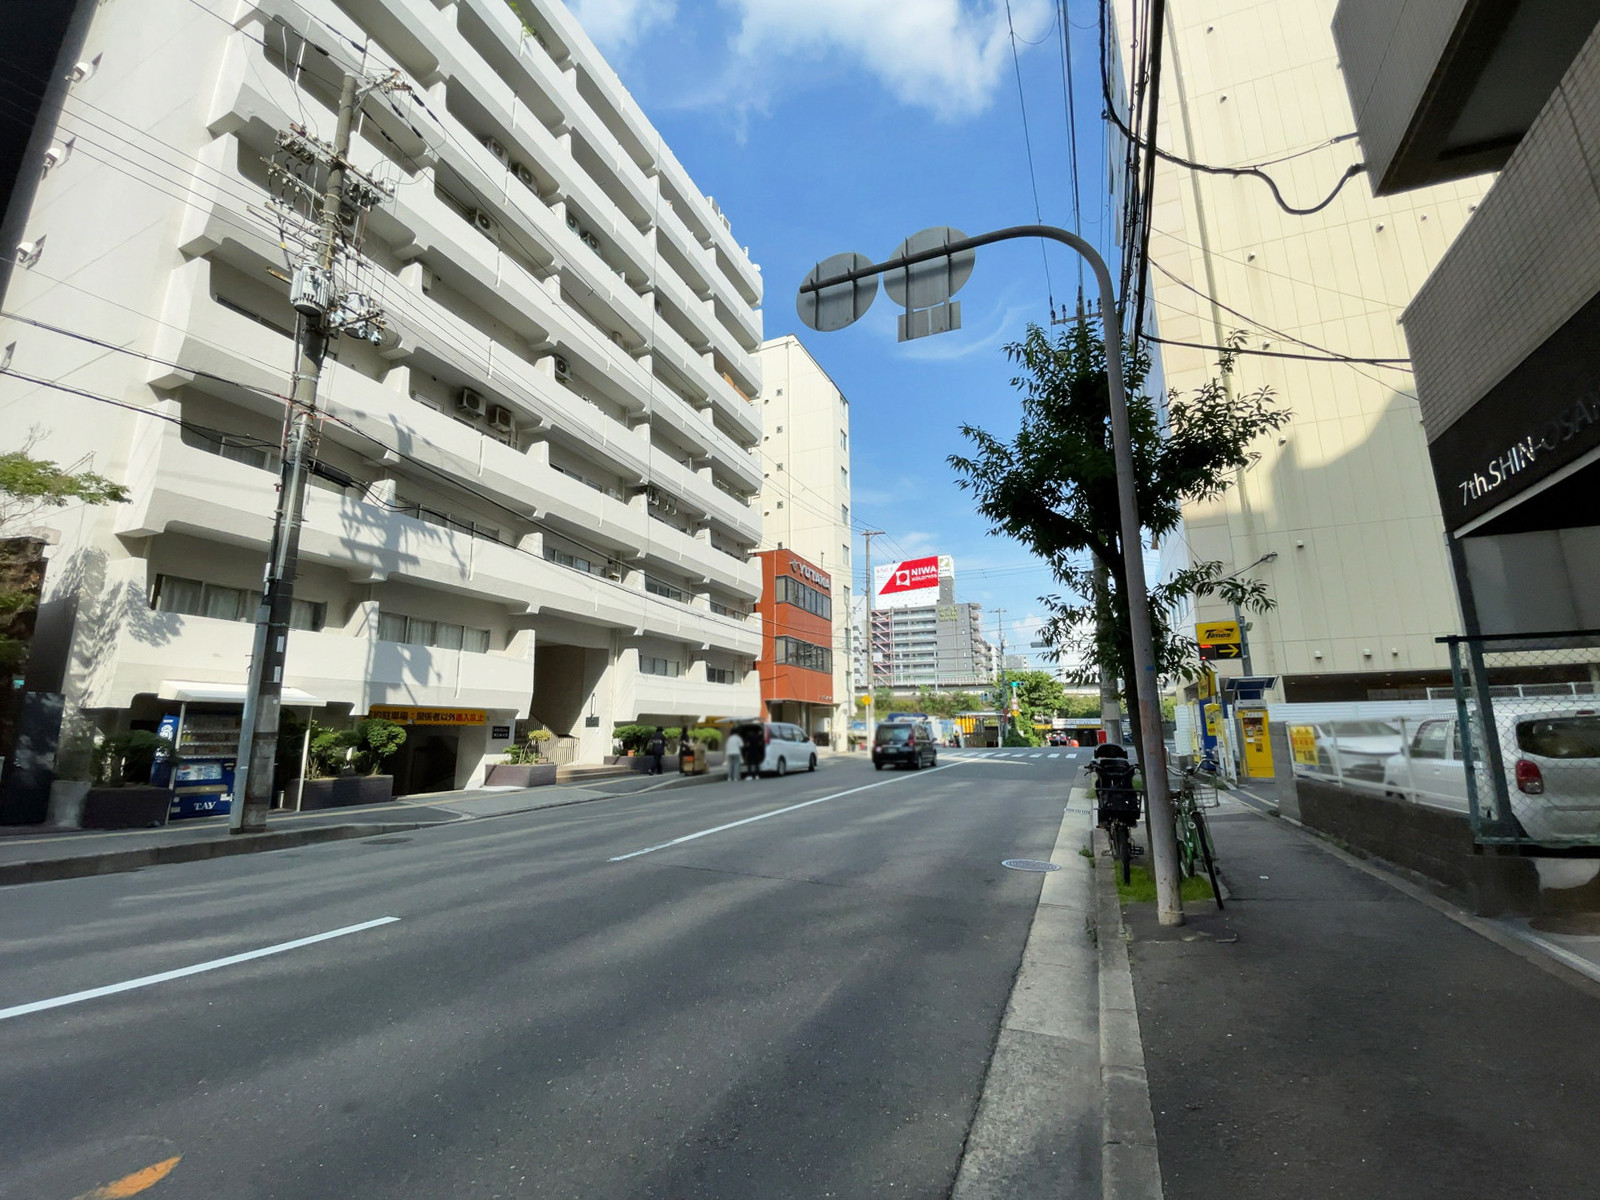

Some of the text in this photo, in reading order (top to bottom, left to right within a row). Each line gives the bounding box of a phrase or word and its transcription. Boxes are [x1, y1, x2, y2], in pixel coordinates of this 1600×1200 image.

[799, 562, 830, 589] YUTAKA
[911, 565, 937, 576] NIWA
[1205, 628, 1234, 639] Times
